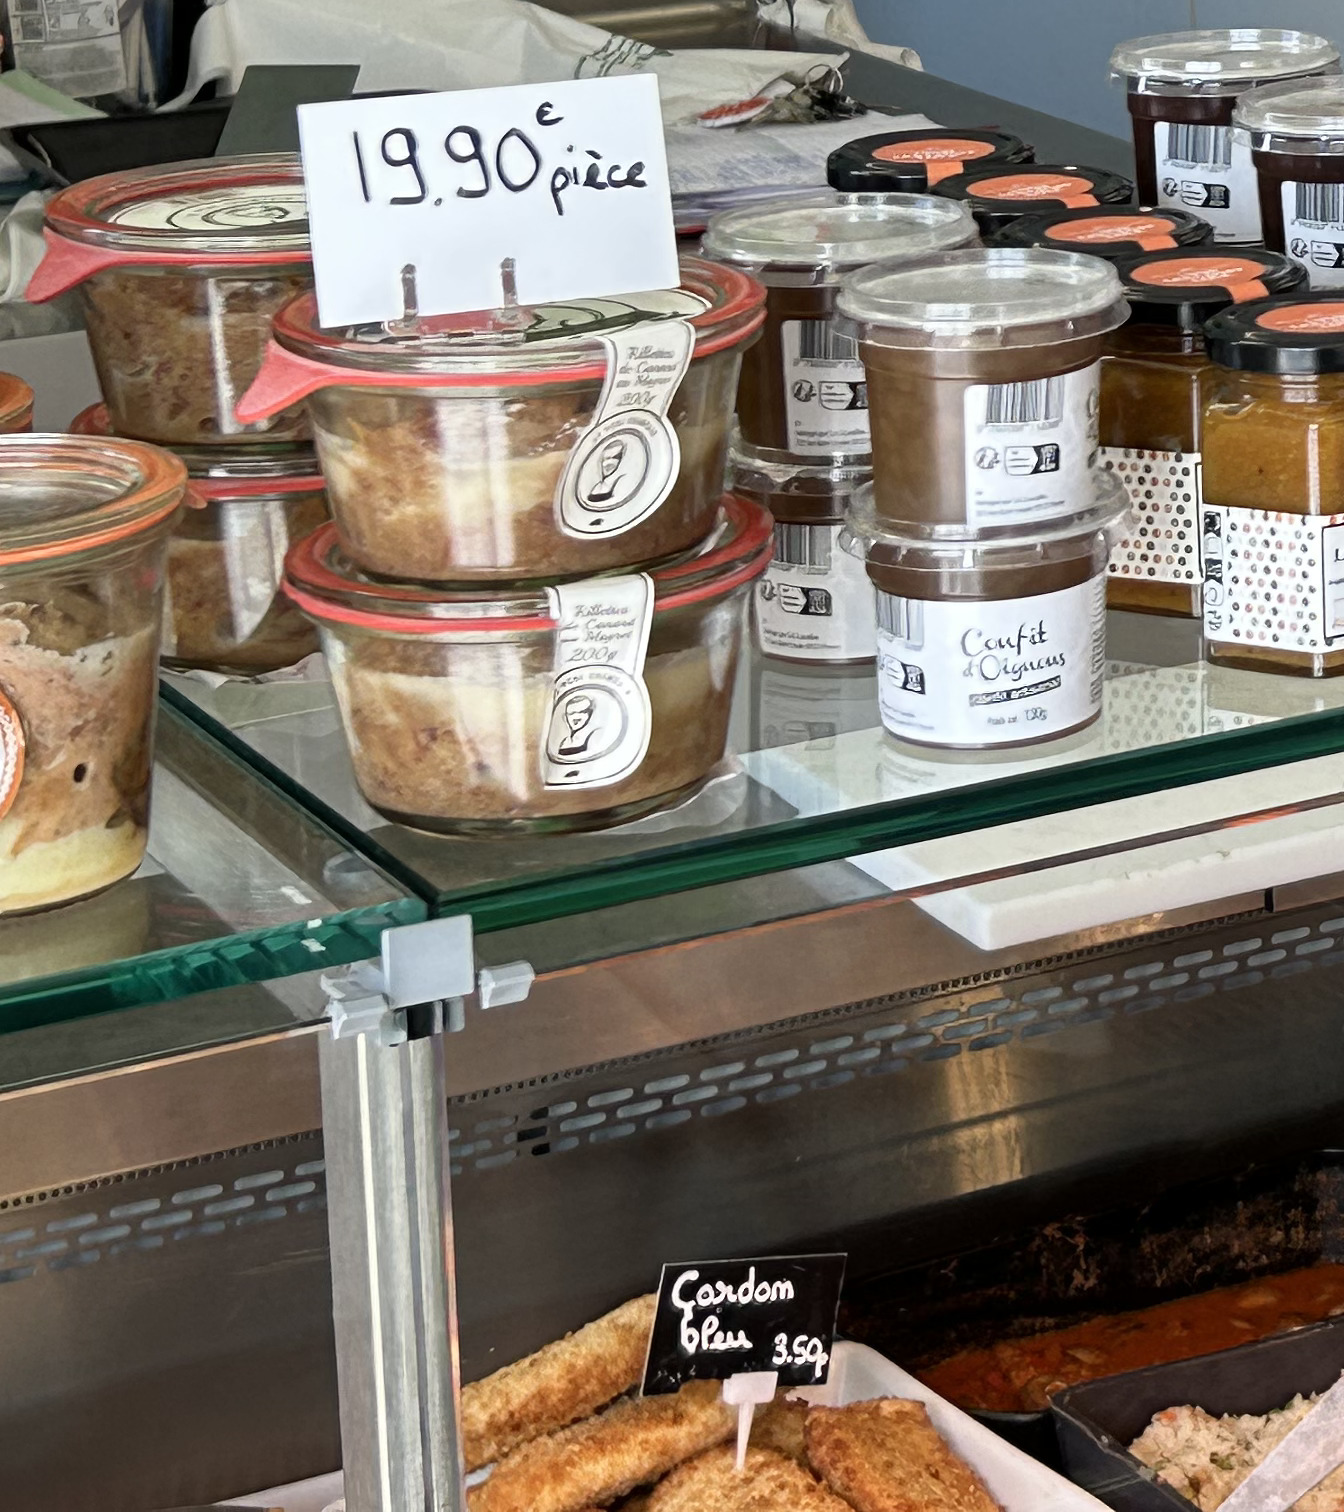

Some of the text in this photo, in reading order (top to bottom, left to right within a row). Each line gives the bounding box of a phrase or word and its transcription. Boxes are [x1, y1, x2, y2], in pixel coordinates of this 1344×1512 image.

[549, 143, 648, 217] pièce
[960, 619, 1049, 657] Confit
[671, 1266, 795, 1311] Cordon
[680, 1314, 754, 1355] bleu
